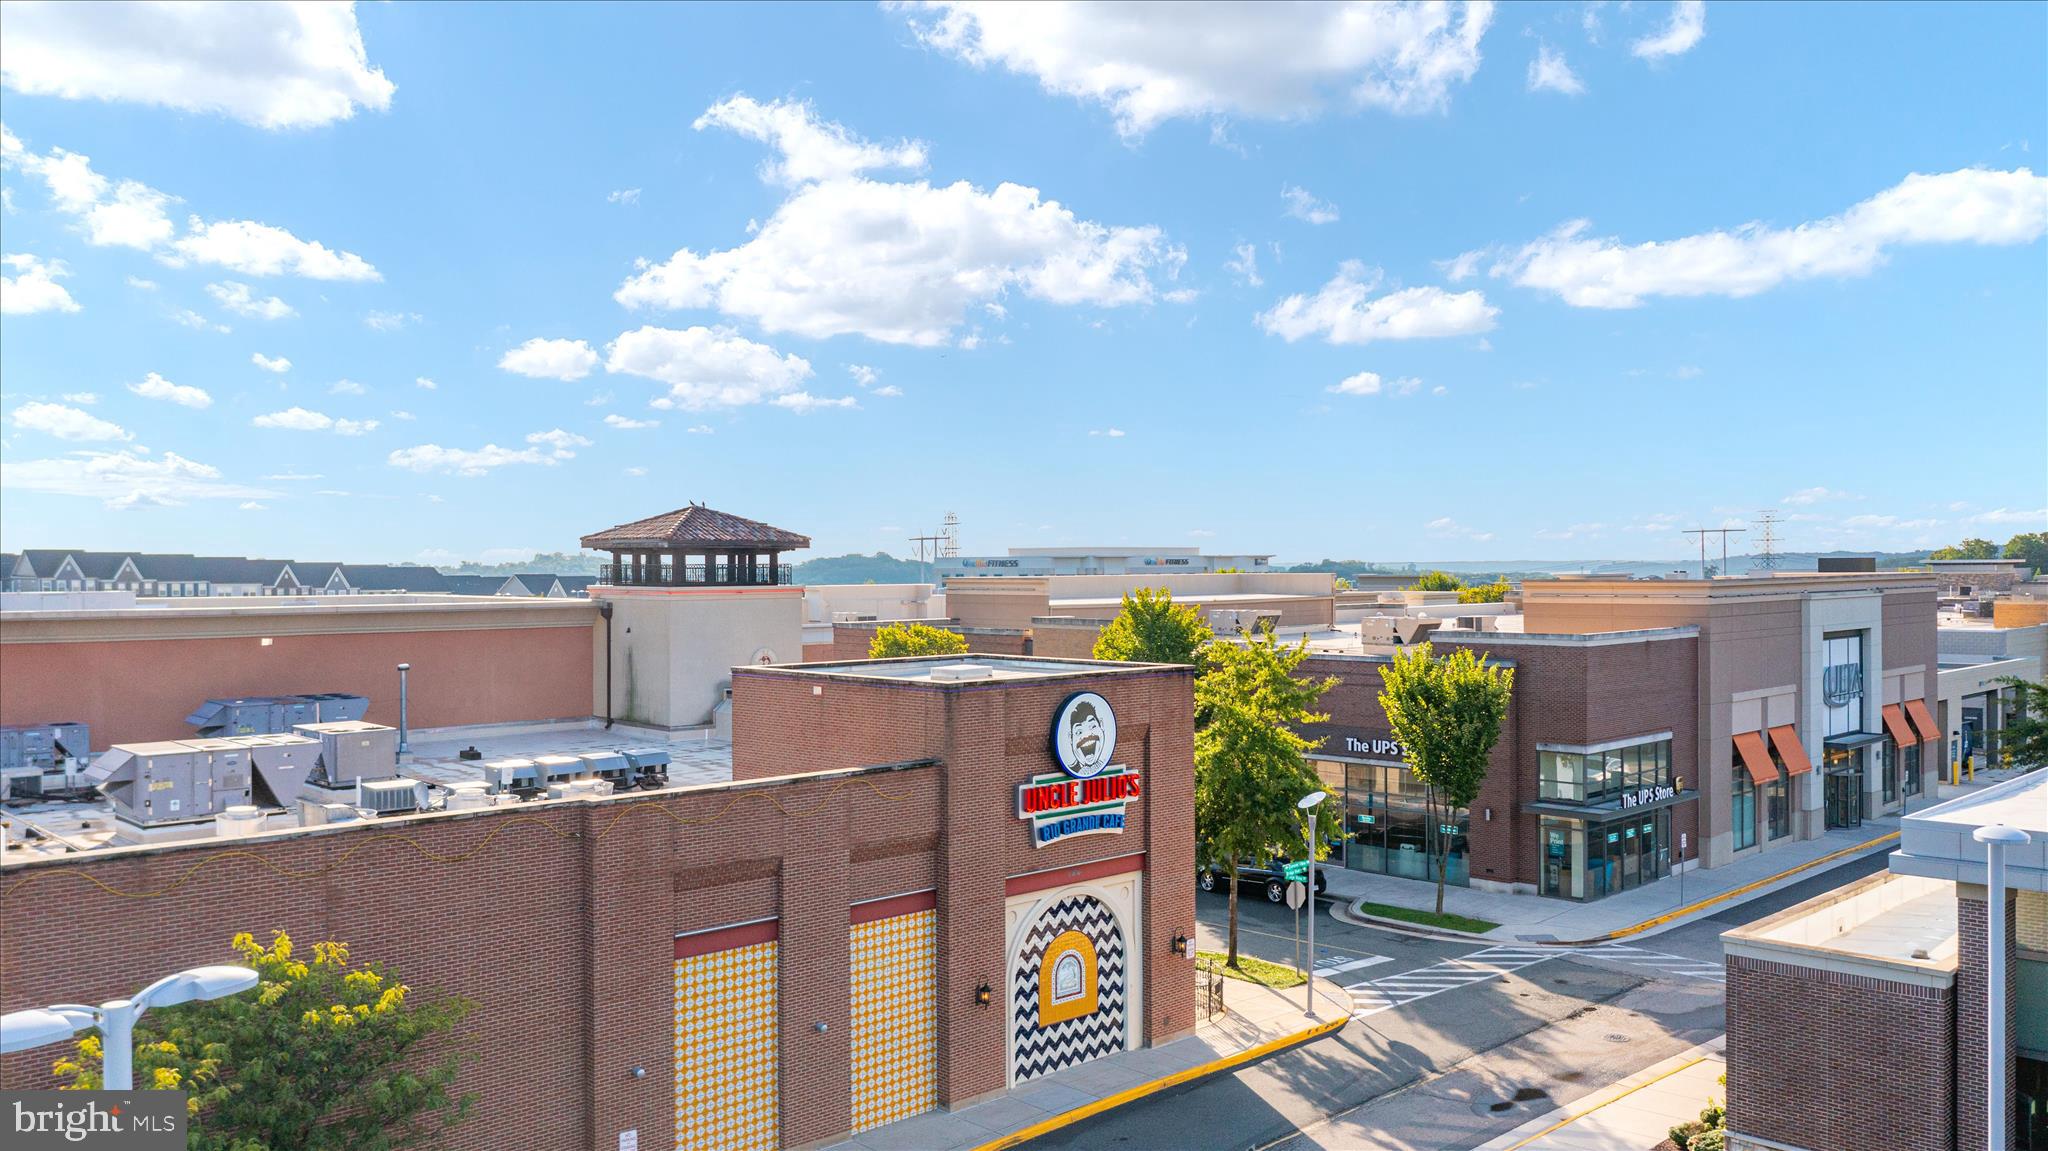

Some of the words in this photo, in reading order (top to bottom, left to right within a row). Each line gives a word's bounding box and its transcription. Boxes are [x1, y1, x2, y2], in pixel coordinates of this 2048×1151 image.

[987, 559, 1019, 568] FITNESS
[1345, 737, 1370, 753] The
[1372, 739, 1399, 756] UPS
[1023, 782, 1078, 813] UNCLE
[1081, 774, 1140, 804] JULIO'S
[1622, 793, 1637, 809] The
[1638, 788, 1654, 805] UPS
[1655, 785, 1674, 801] Store
[1041, 825, 1062, 842] RIO
[1063, 815, 1101, 835] GRANDE
[1102, 814, 1125, 829] CAFE
